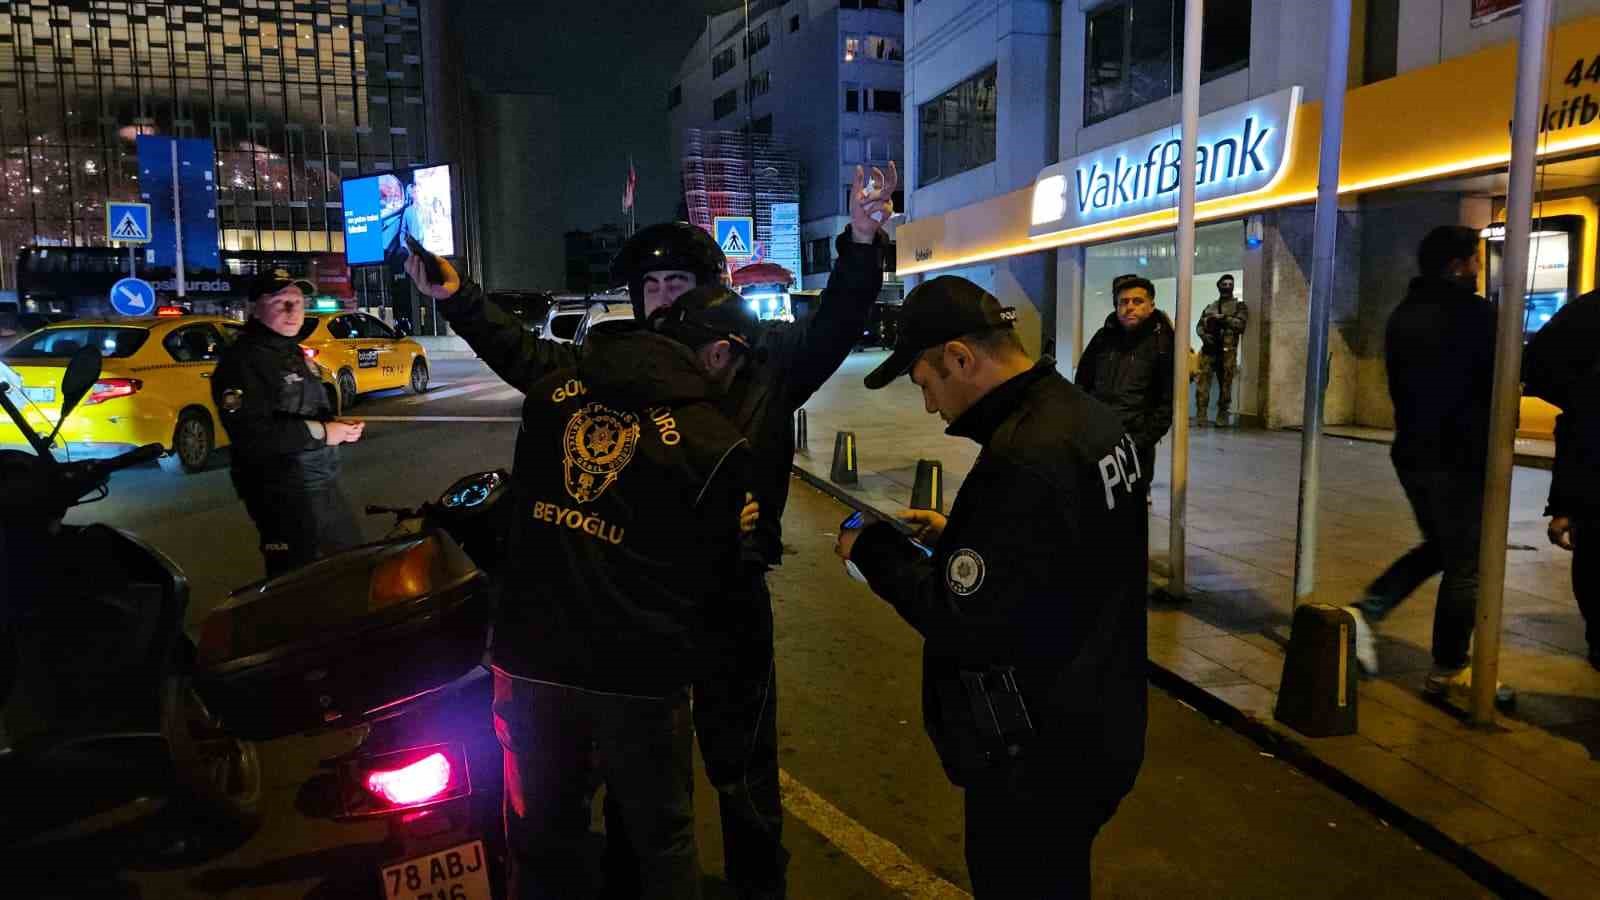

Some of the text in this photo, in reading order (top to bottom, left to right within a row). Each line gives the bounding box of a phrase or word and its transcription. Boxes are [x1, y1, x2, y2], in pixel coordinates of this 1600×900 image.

[533, 501, 625, 544] BEYOĞLU
[387, 845, 482, 897] 78 ABJ
